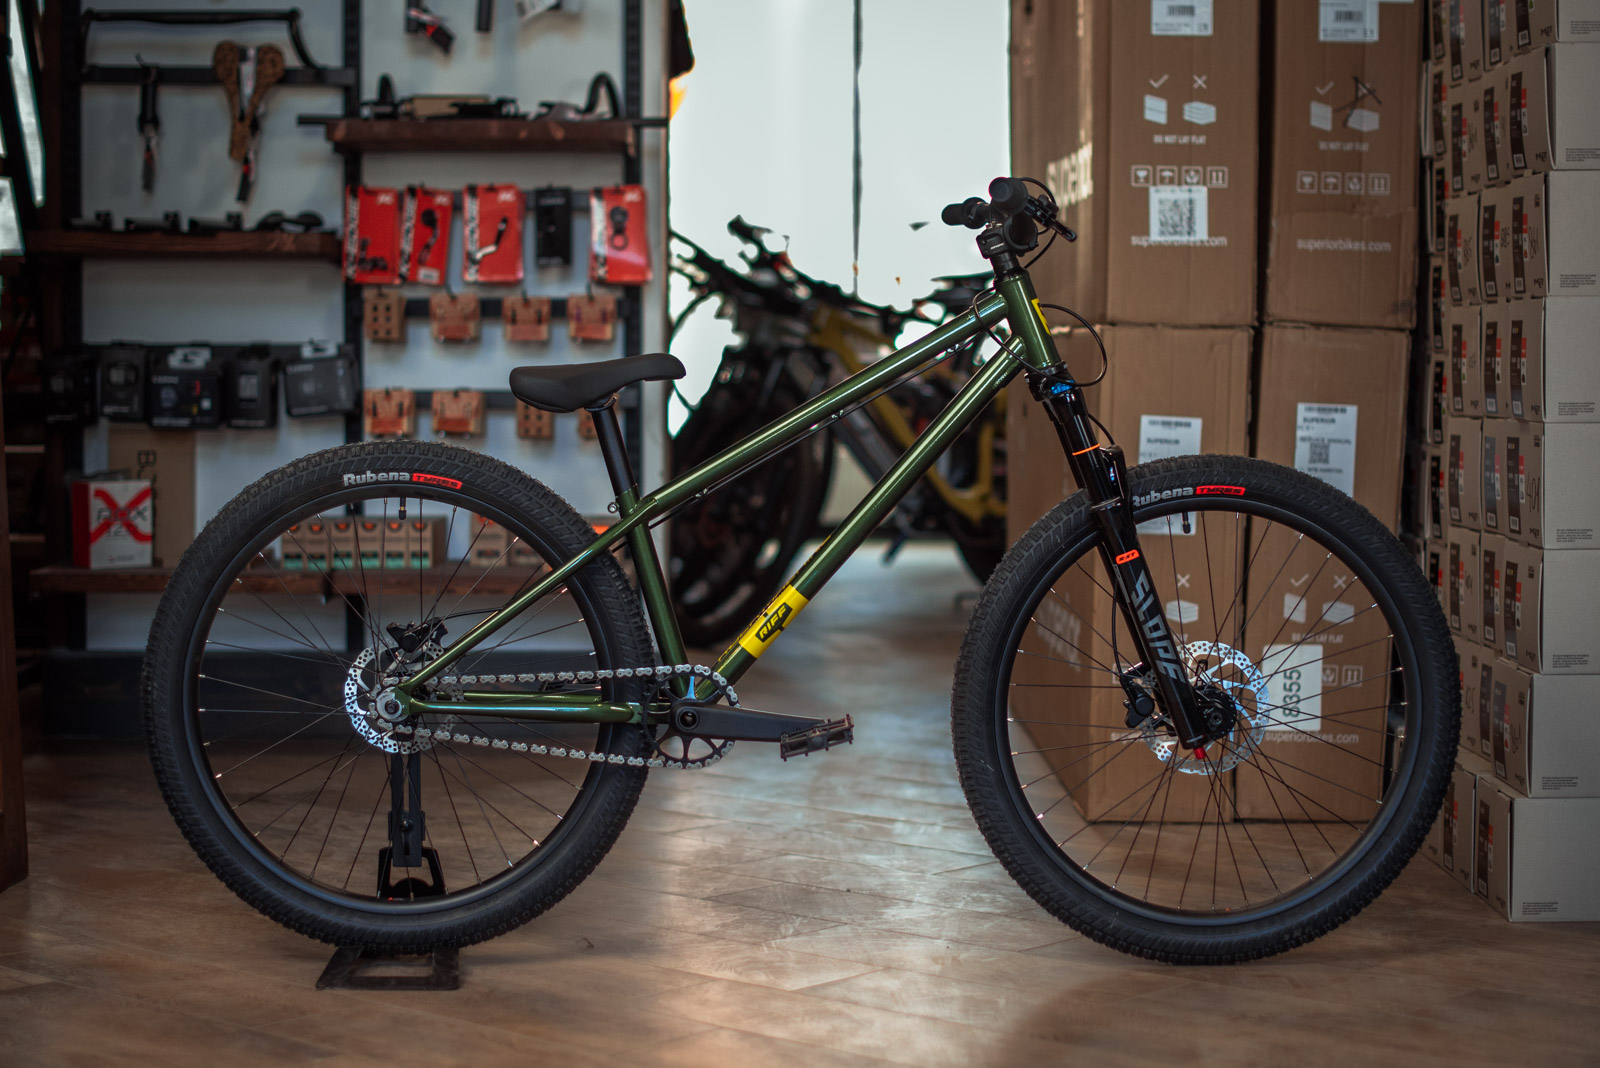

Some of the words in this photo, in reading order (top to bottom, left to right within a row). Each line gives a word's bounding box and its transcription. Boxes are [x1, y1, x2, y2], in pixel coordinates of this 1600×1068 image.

[1178, 134, 1190, 144] LAY
[1191, 134, 1207, 144] FLAT
[1535, 151, 1547, 163] MET
[1296, 238, 1392, 252] superiorbikes.com
[1534, 278, 1544, 289] MET
[1531, 405, 1540, 416] MET
[342, 470, 411, 487] Rubena
[1530, 527, 1540, 539] MET
[1118, 551, 1137, 562] RST
[759, 604, 787, 639] RIFF
[1131, 569, 1187, 684] SLOPE
[1316, 632, 1327, 643] LAY
[1328, 632, 1344, 643] FLAT
[1282, 668, 1302, 718] 8355
[1264, 731, 1359, 744] superiorbikes.com
